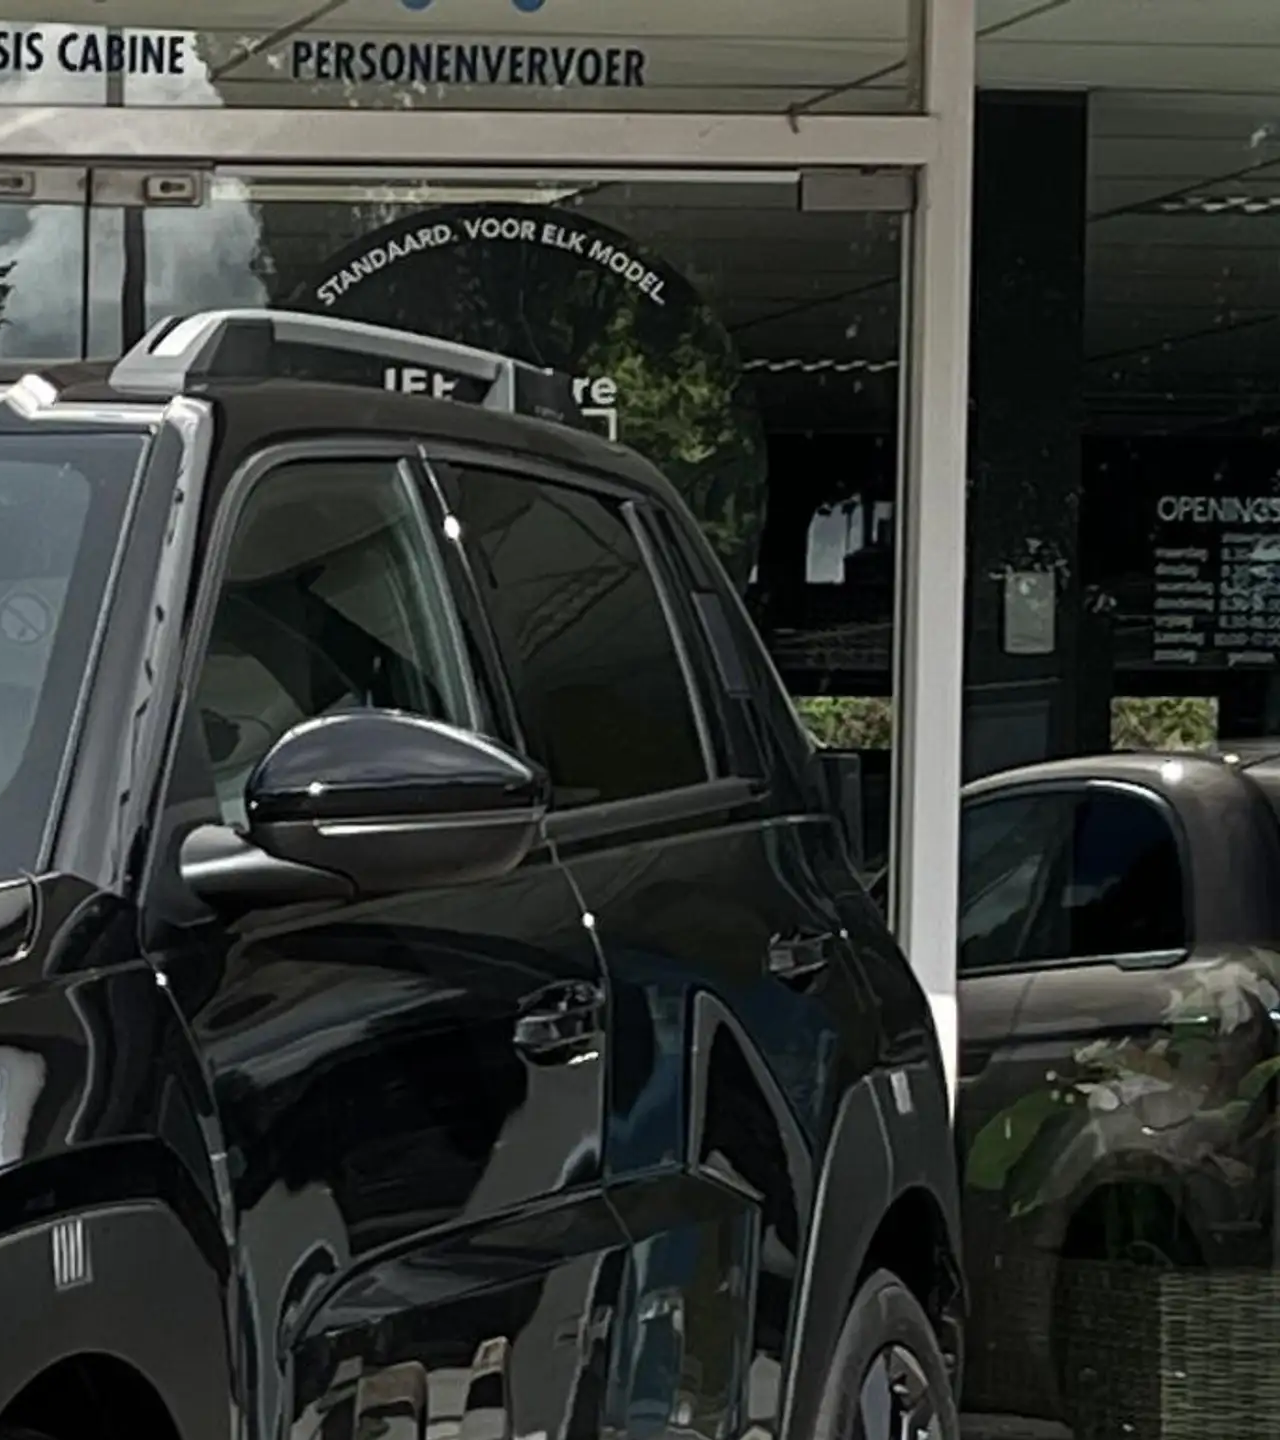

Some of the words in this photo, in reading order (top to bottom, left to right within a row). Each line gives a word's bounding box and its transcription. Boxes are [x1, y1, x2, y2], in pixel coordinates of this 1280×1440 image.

[58, 32, 185, 75] CABINE
[292, 40, 645, 88] PERSONENVERVOER
[316, 223, 458, 306] STANDAARD.
[464, 217, 536, 241] VOOR
[541, 224, 588, 254] ELK
[589, 239, 665, 306] MODEL
